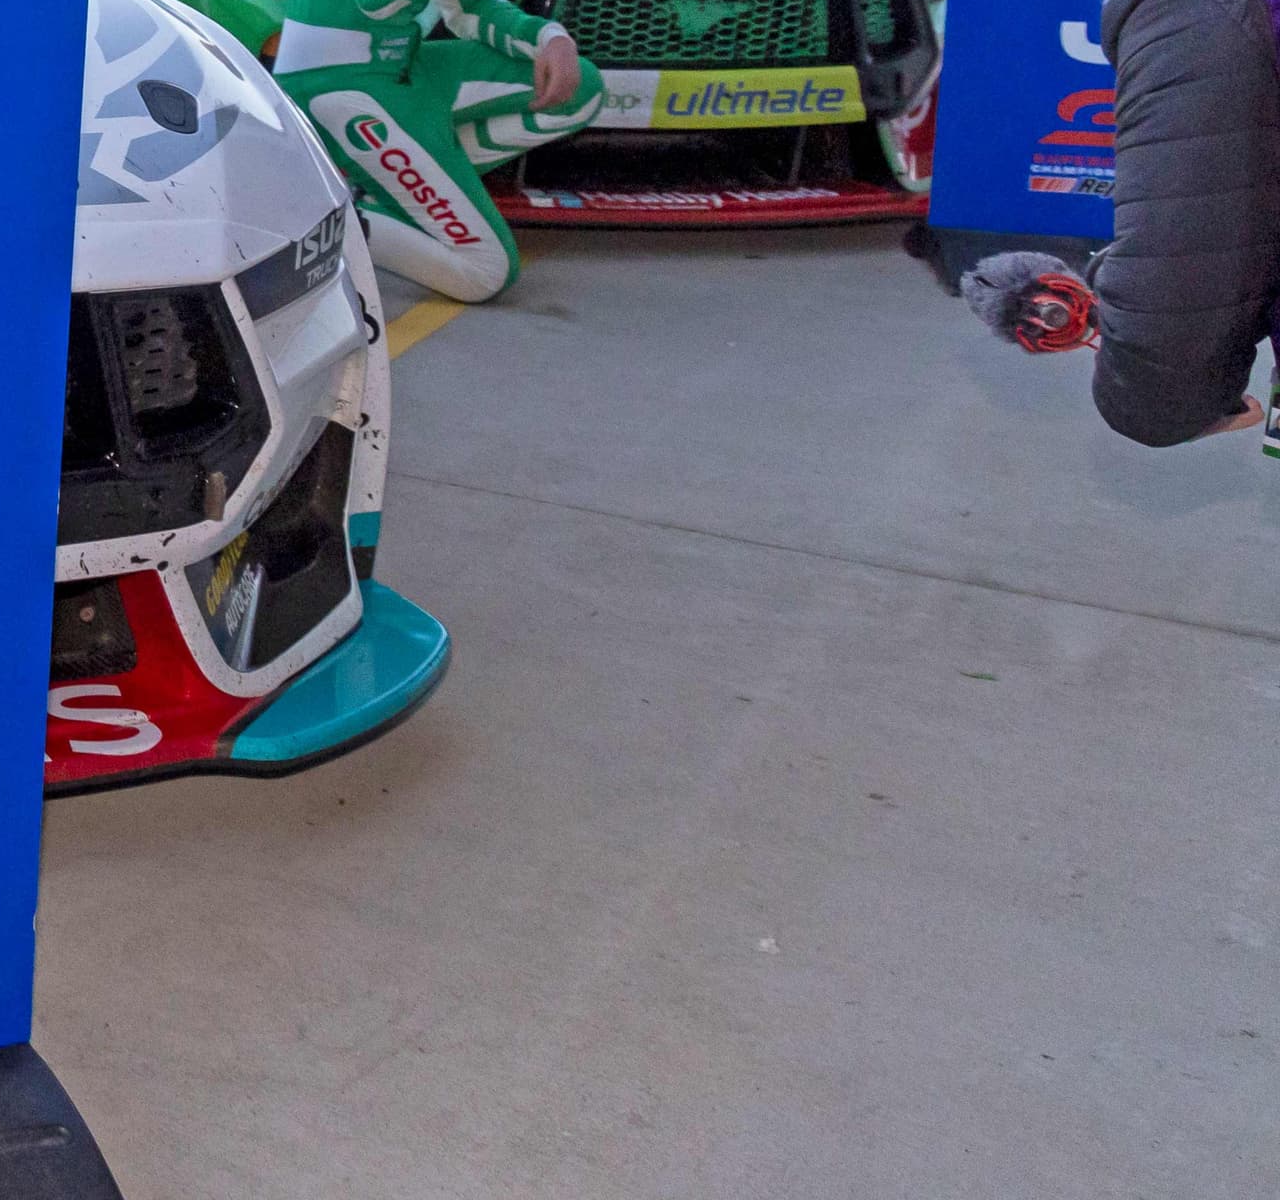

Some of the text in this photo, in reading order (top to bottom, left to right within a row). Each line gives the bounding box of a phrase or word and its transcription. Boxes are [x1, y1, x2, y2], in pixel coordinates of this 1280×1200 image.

[666, 80, 845, 117] ultimate
[380, 148, 482, 246] Castrol
[294, 208, 346, 271] ISUZ
